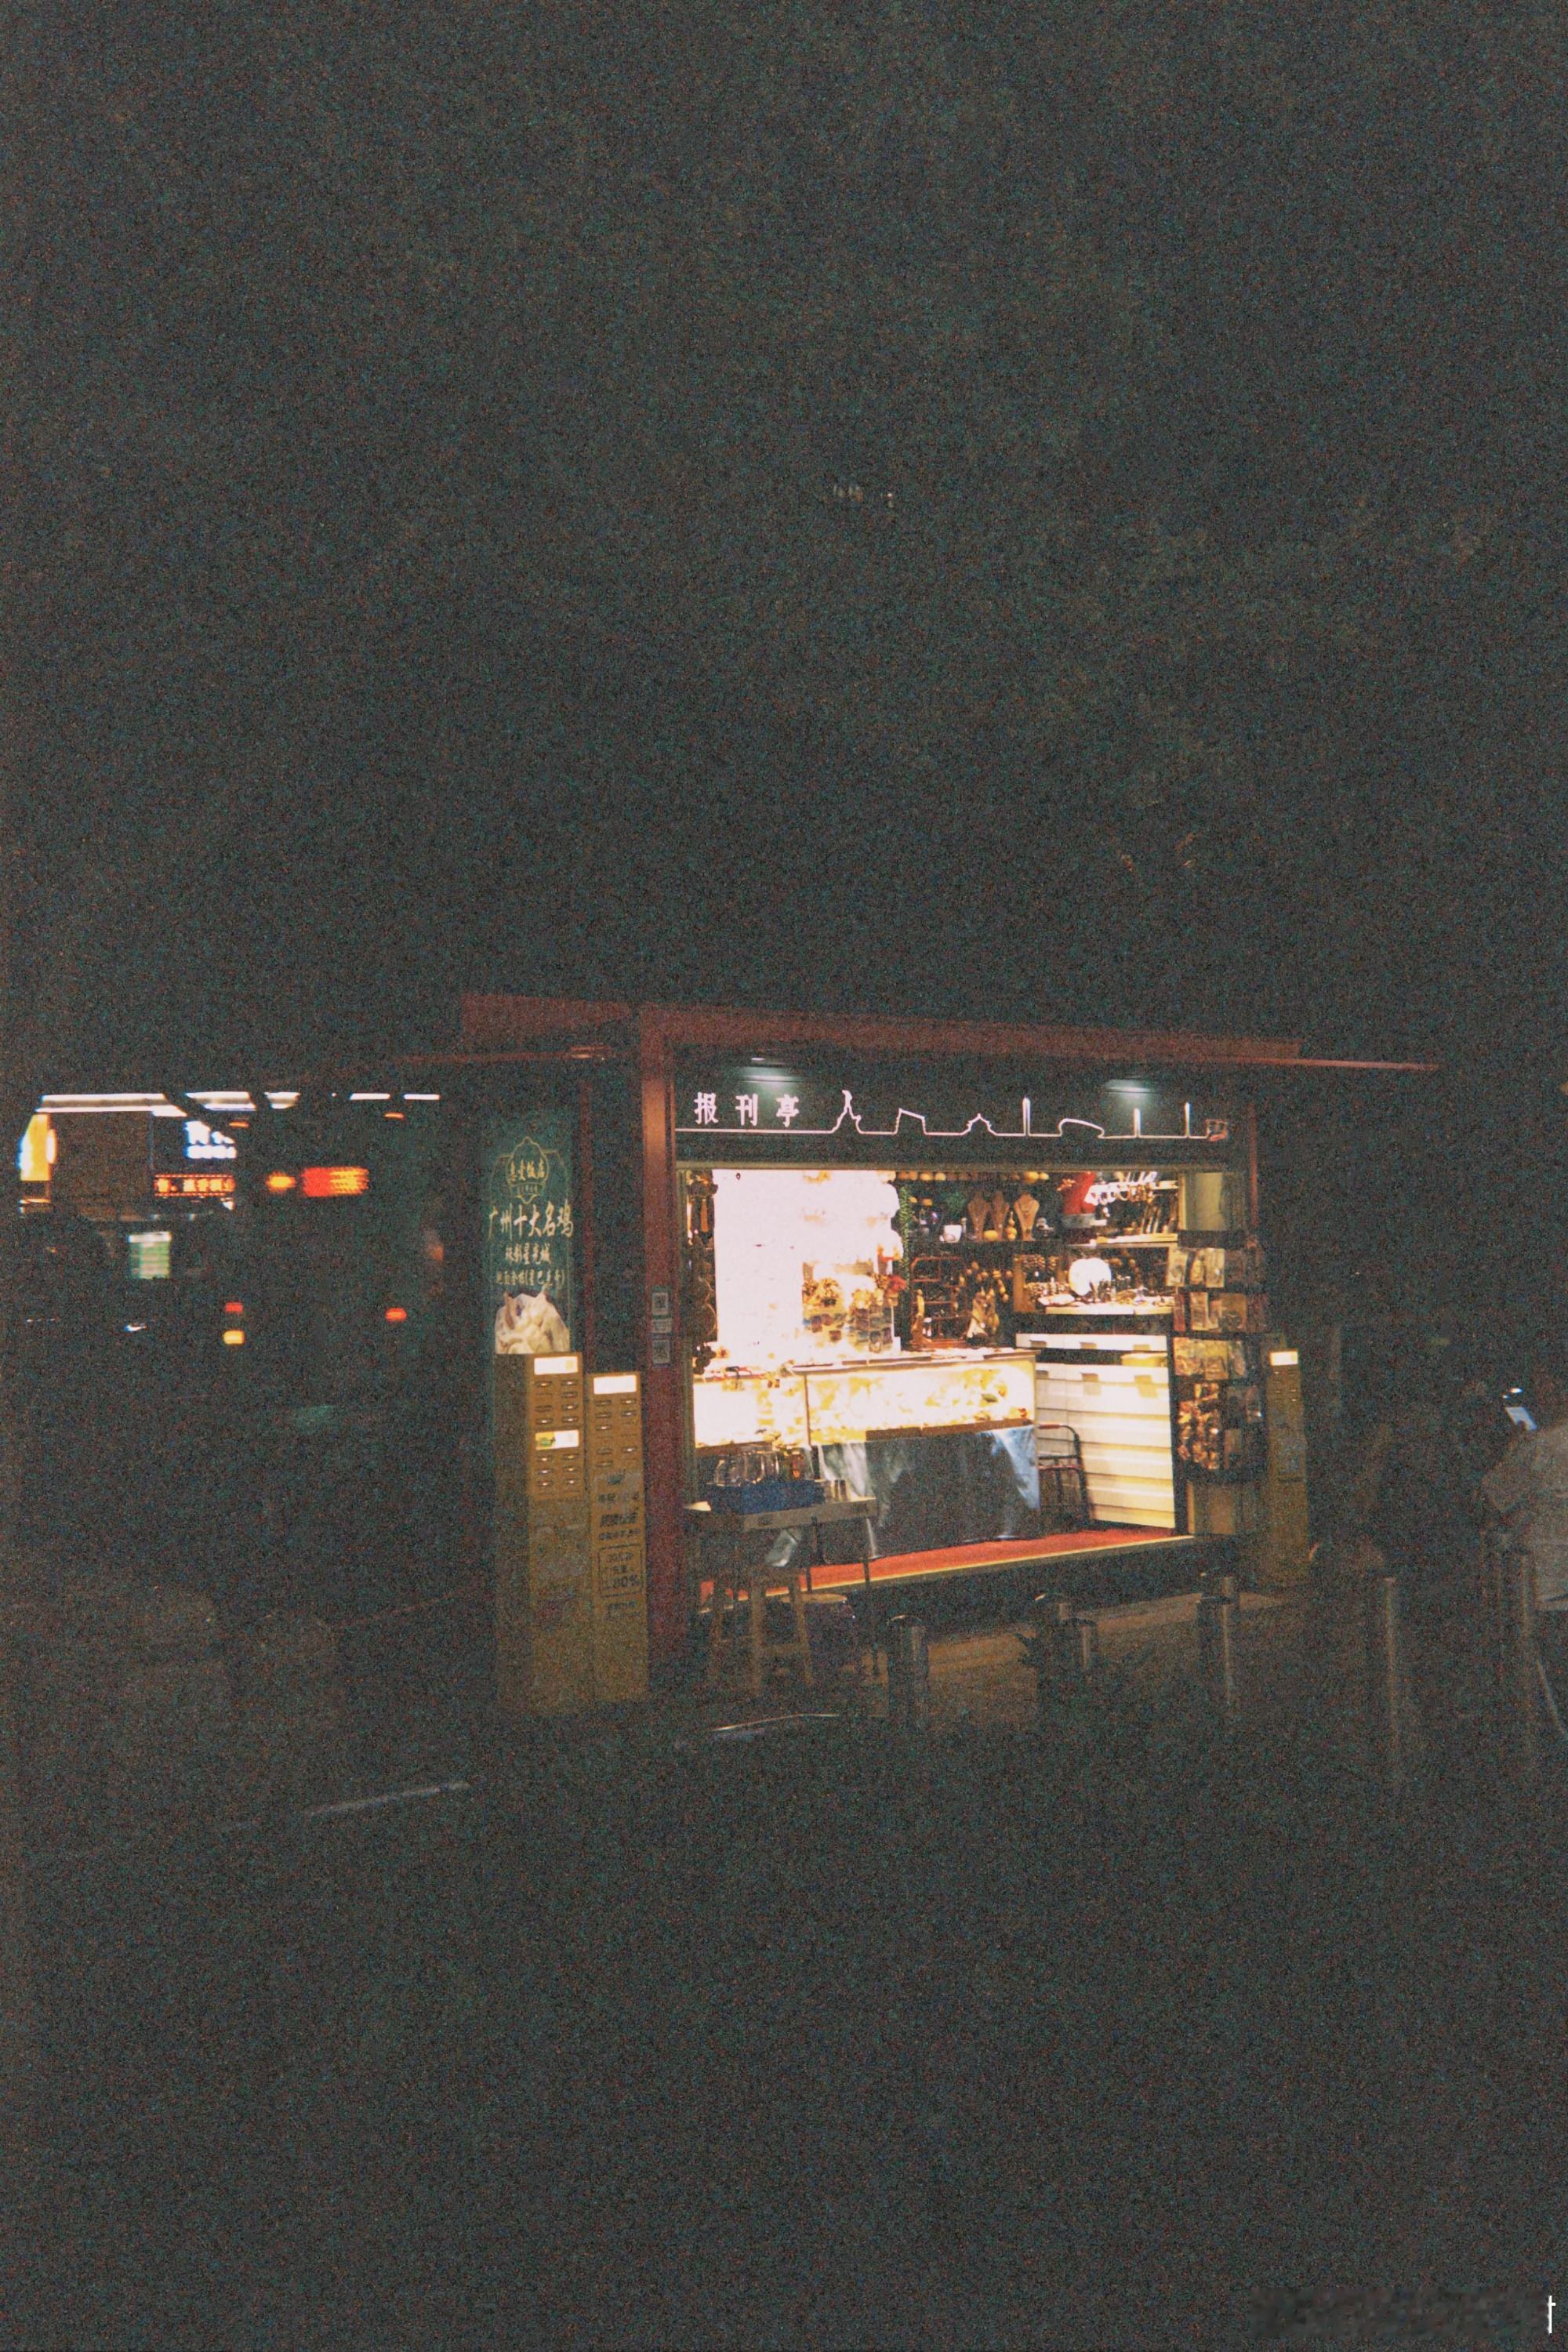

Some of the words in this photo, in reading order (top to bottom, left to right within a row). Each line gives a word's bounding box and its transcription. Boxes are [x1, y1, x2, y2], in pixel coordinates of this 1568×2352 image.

[693, 1091, 800, 1127] 报刊亭
[488, 1200, 573, 1240] 广州十大名鸡
